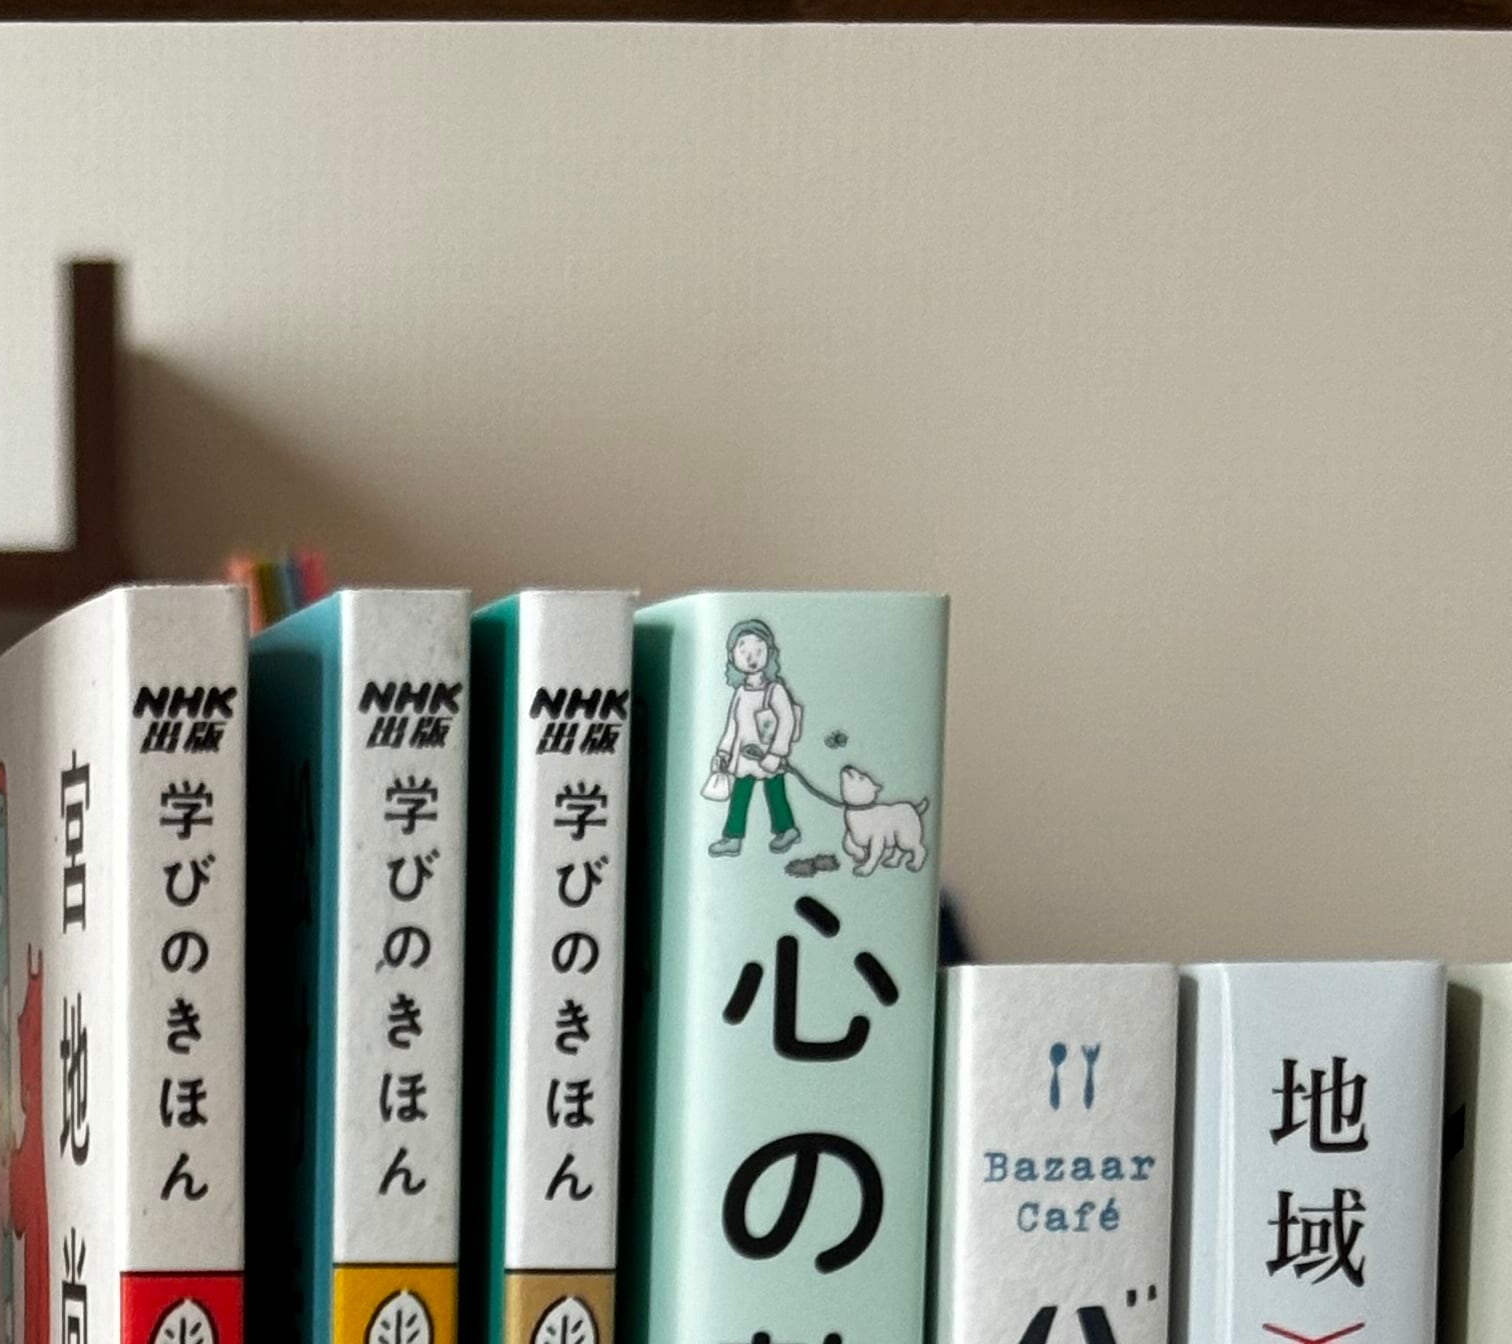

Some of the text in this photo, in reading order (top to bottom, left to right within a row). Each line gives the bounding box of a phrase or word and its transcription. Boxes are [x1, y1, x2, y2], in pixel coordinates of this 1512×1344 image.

[132, 685, 237, 719] NHK
[358, 681, 462, 716] NHK
[529, 687, 630, 721] NHK
[140, 720, 226, 754] 出版
[366, 716, 453, 750] 出版
[536, 723, 622, 756] 出版
[159, 780, 215, 1201] 学びのきほん
[377, 775, 440, 1197] 学びのきほん
[544, 781, 609, 1202] 学びのきほん
[983, 1151, 1157, 1184] Bazaar
[1016, 1196, 1120, 1234] Café
